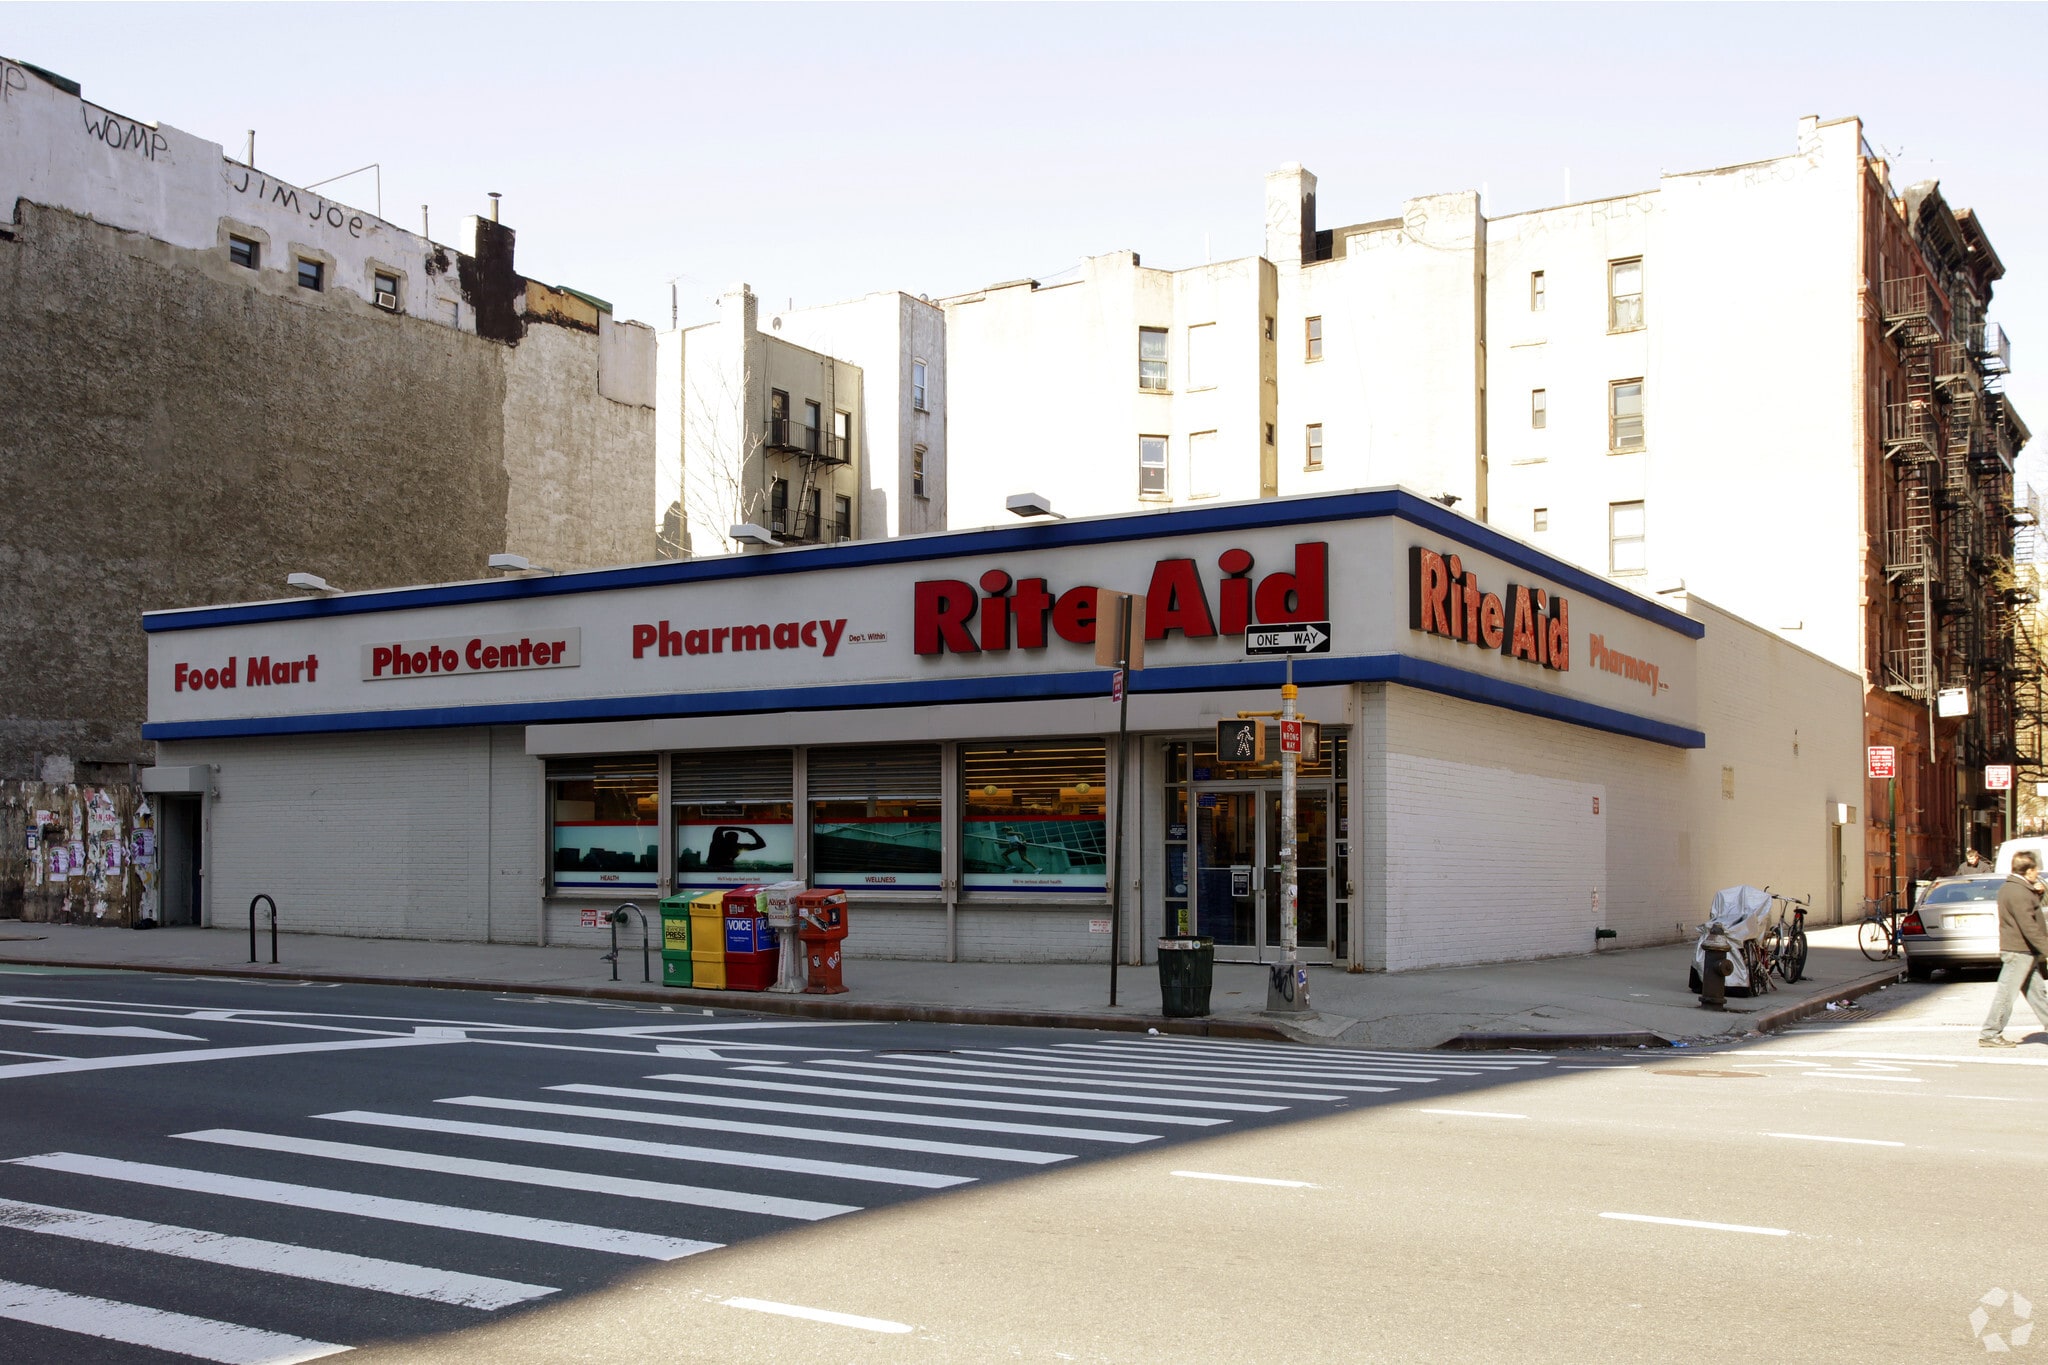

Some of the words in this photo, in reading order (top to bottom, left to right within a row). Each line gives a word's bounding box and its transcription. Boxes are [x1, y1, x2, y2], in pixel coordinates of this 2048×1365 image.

[81, 105, 168, 161] WOMP
[234, 172, 301, 213] JIM
[914, 569, 1098, 655] Rite
[1144, 541, 1329, 641] Aid
[1409, 546, 1504, 650] Rite
[1501, 584, 1569, 671] Aid
[633, 618, 848, 659] Pharmacy
[867, 633, 886, 641] Within
[1257, 634, 1280, 646] ONE
[1294, 632, 1319, 645] WAY
[174, 656, 237, 692] Food
[246, 654, 319, 687] Mart
[373, 644, 459, 677] Photo
[465, 638, 566, 670] Center
[1589, 632, 1659, 696] Pharmacy
[1283, 732, 1299, 741] WRONG
[865, 876, 896, 884] WELLNESS
[665, 931, 686, 941] PRESS
[727, 920, 752, 931] VOICE
